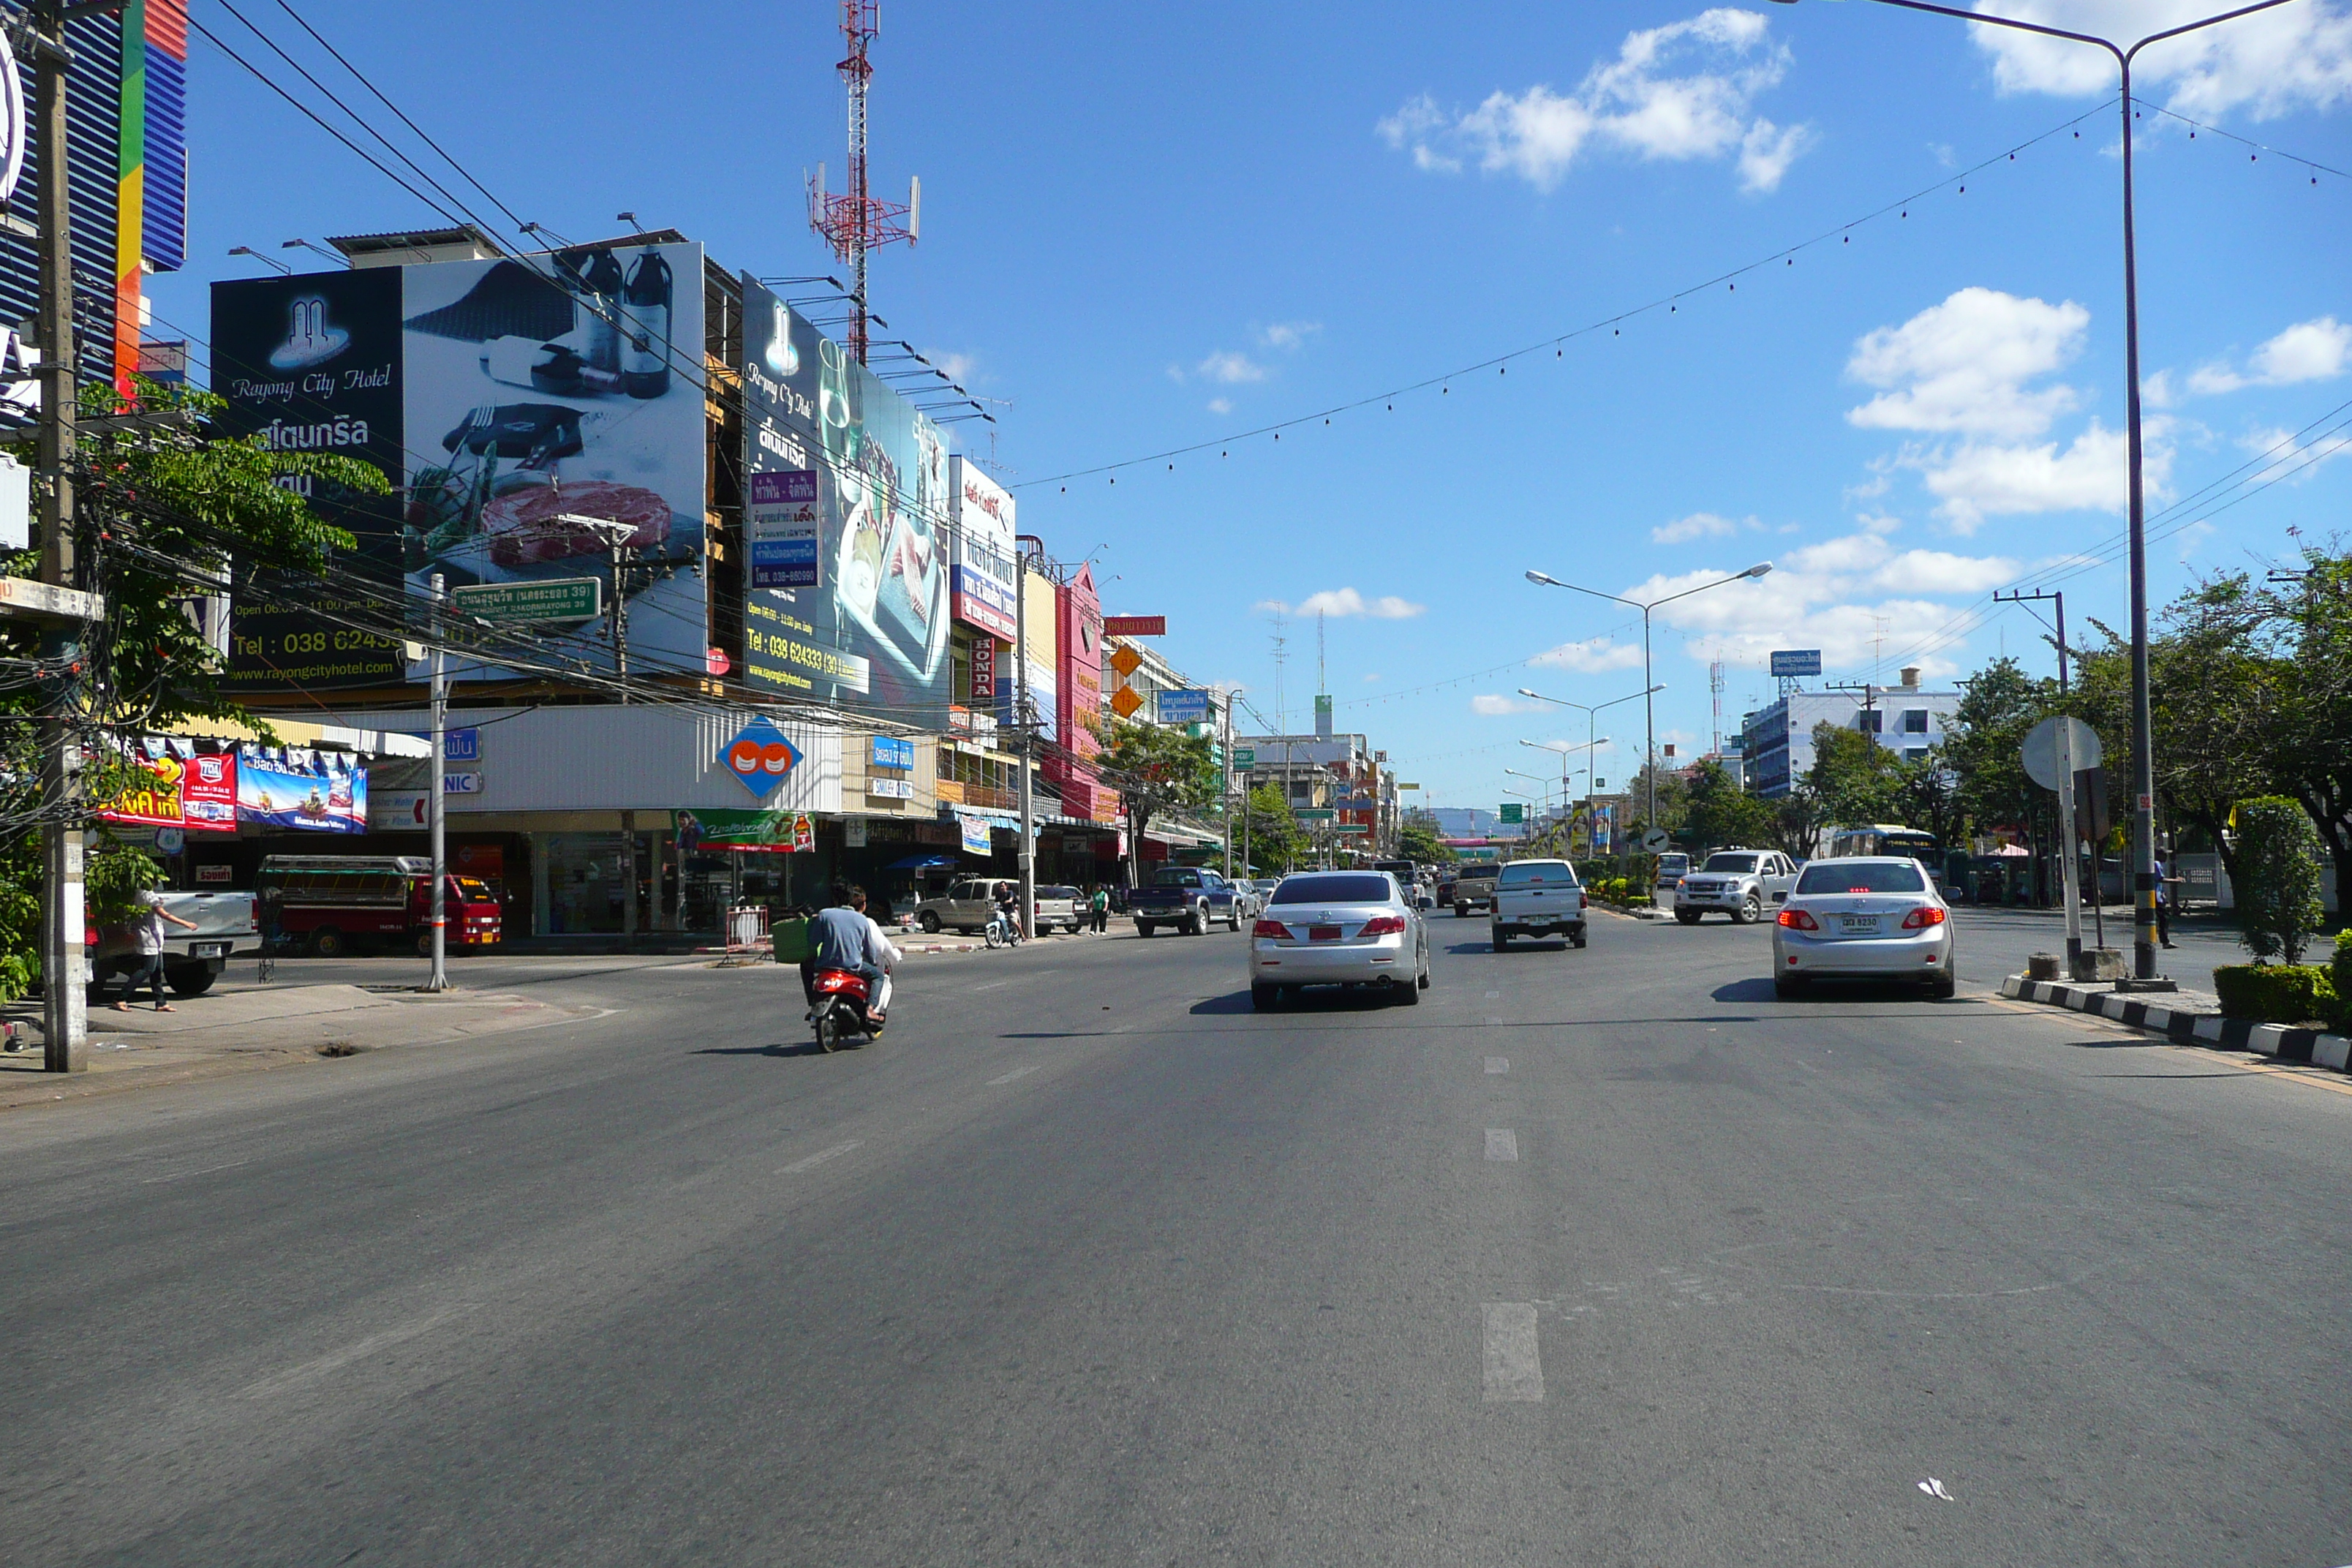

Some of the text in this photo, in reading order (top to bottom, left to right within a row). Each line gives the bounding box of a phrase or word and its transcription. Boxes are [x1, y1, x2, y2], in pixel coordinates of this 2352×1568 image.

[233, 363, 391, 404] Rayong City Hotel
[749, 362, 814, 420] Rayong City Hotel
[755, 477, 780, 500] ทำฟัน
[788, 475, 814, 499] จัดฟัน
[571, 586, 590, 598] 39)
[235, 605, 261, 618] Open
[234, 636, 262, 655] Tel
[284, 632, 326, 653] 038
[747, 627, 762, 652] Tel
[769, 635, 788, 660] 038
[790, 641, 822, 670] 624333
[824, 652, 837, 675] (30
[233, 662, 393, 682] www.rayongcityhotel.com
[749, 664, 812, 690] www.rayongcityhotel.com
[975, 639, 990, 695] HONDA
[1376, 752, 1384, 761] 7
[202, 764, 220, 775] TOA
[2140, 796, 2152, 808] 92
